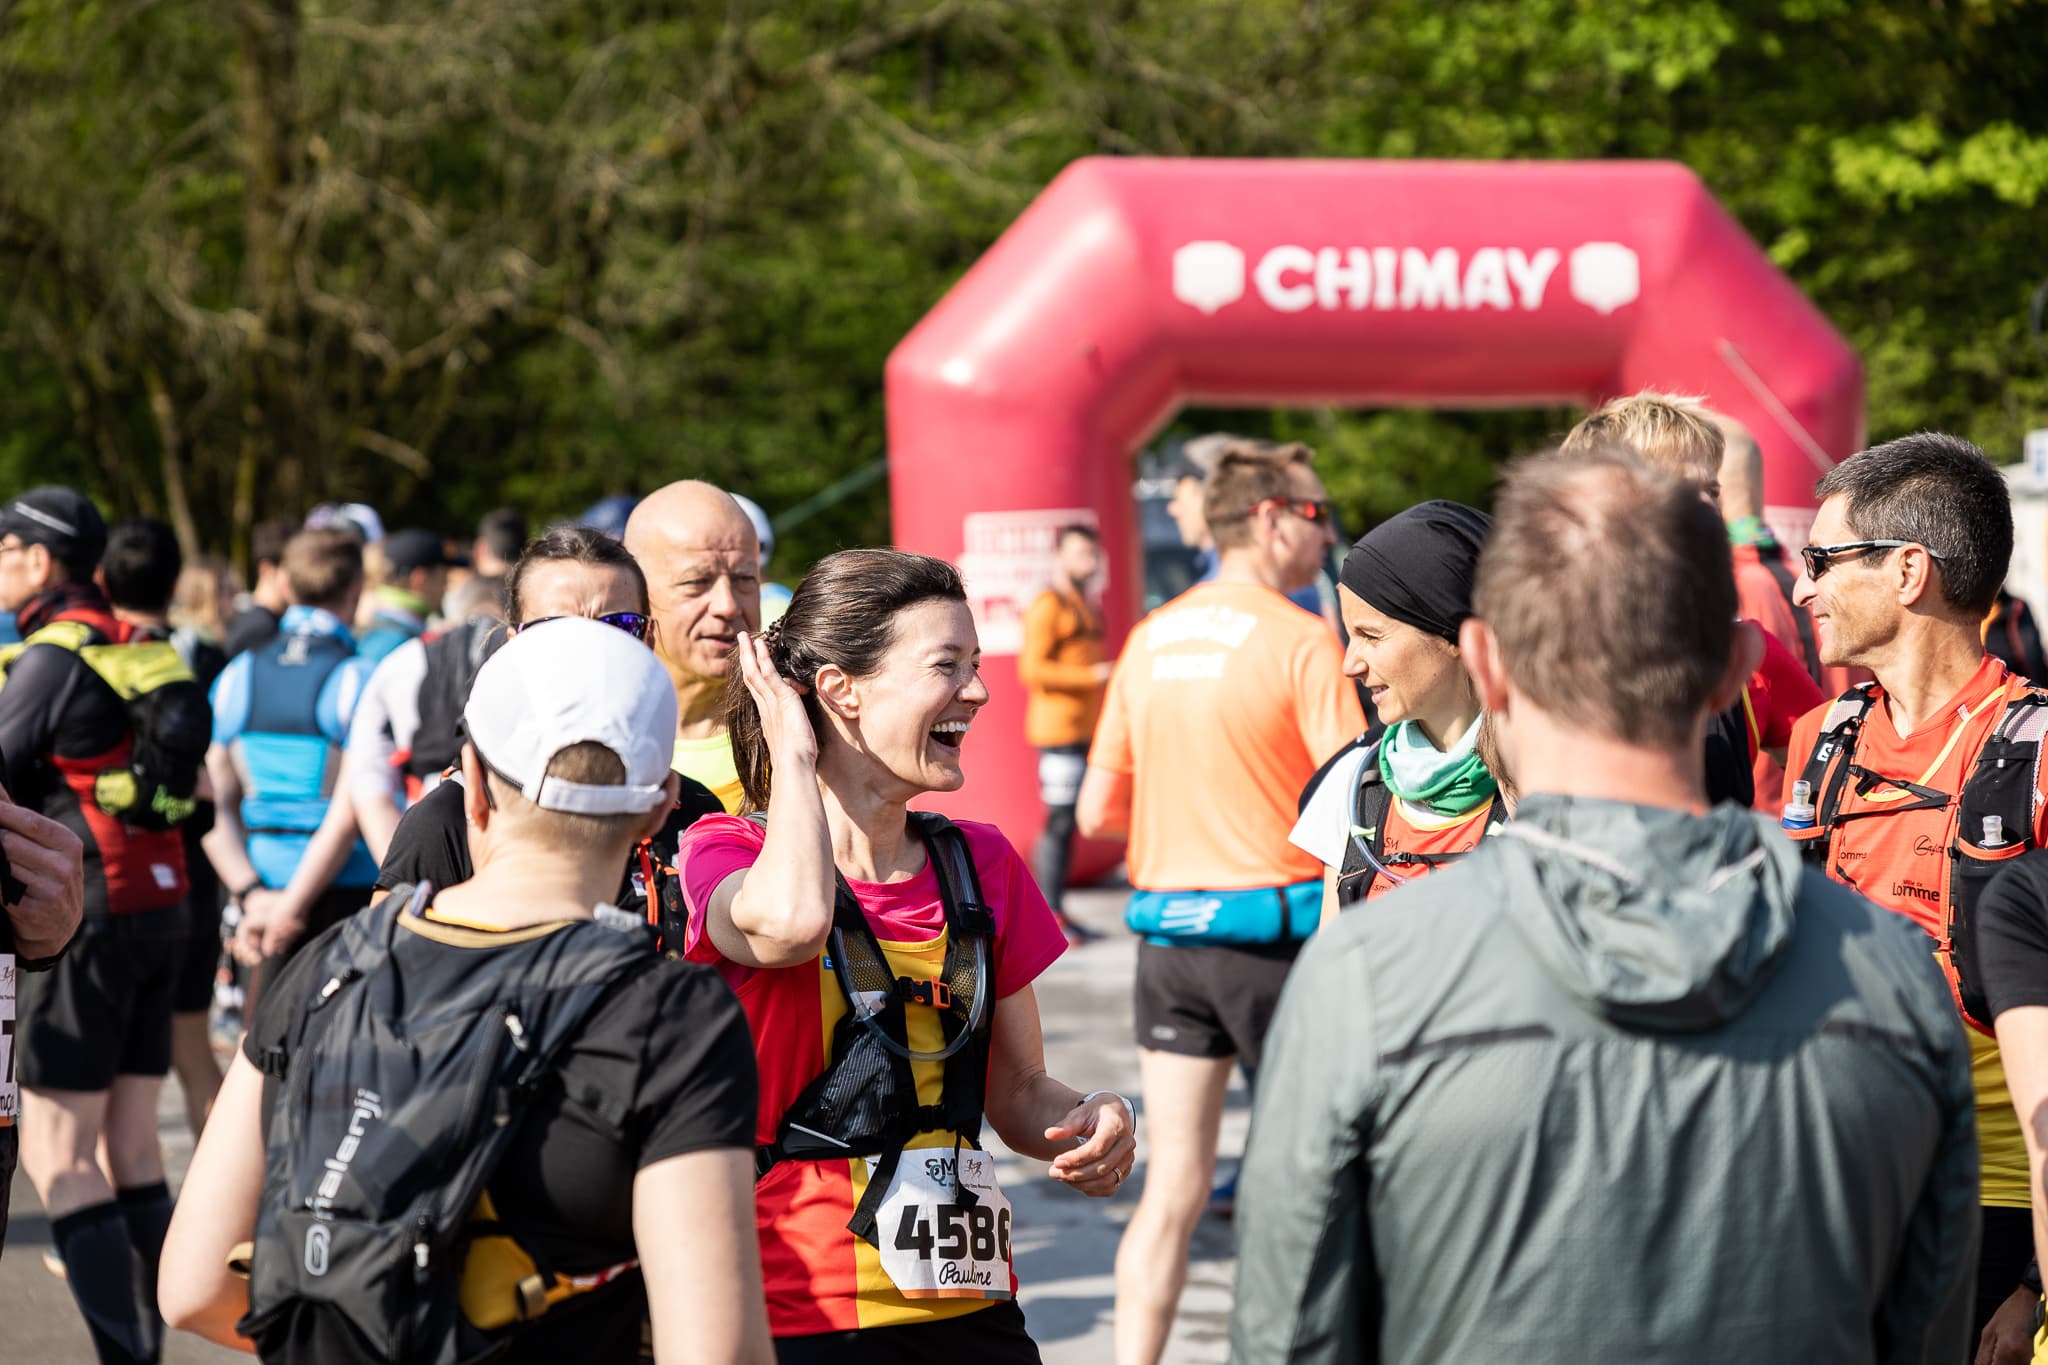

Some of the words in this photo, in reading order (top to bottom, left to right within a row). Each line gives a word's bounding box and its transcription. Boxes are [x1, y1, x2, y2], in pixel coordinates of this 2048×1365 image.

[1253, 244, 1561, 312] CHIMAY
[1892, 882, 1940, 902] Lomme
[939, 1261, 992, 1286] Pauline
